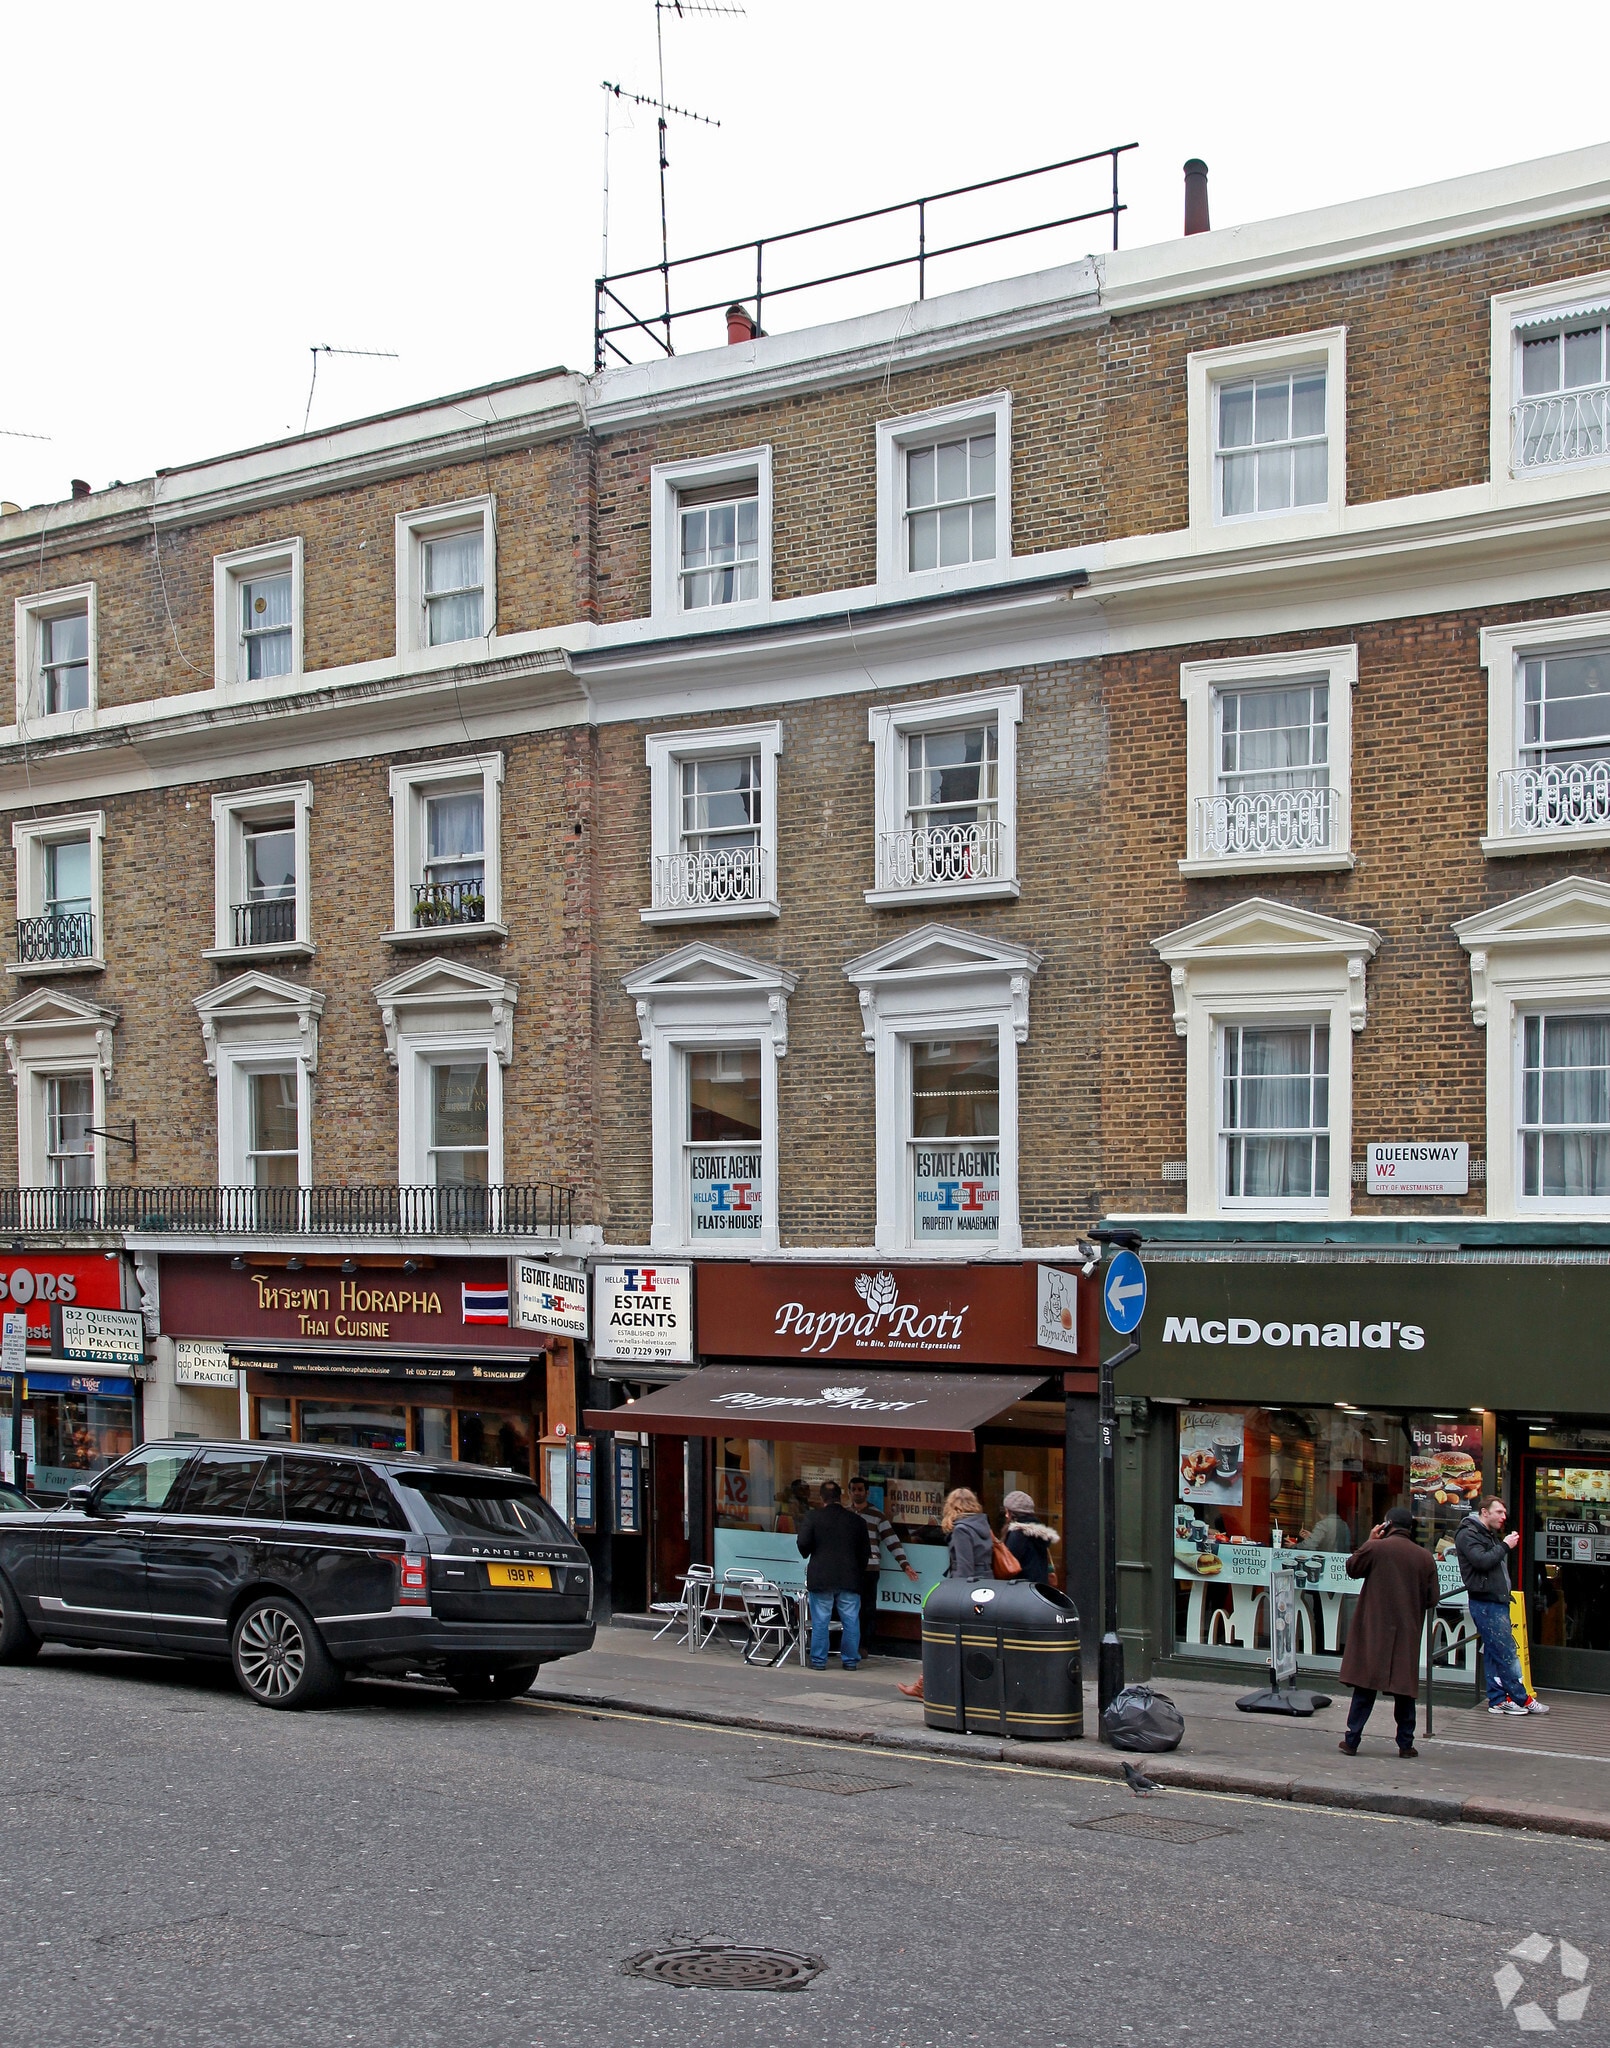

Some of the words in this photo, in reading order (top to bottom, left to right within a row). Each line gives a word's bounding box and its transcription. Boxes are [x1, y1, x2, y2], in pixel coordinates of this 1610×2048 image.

[1375, 1147, 1459, 1161] QUEENSWAY
[692, 1156, 727, 1179] ESTATE
[728, 1155, 762, 1179] AGENT
[917, 1152, 956, 1177] ESTATE
[1375, 1163, 1396, 1177] W2
[693, 1192, 717, 1203] HELLAS
[746, 1191, 762, 1202] HELVE
[917, 1191, 944, 1202] HELLAS
[977, 1190, 1000, 1202] HELVETI
[922, 1216, 954, 1231] PROPERTY
[521, 1266, 551, 1288] ESTATE
[552, 1273, 585, 1295] AGENTS
[604, 1276, 628, 1284] HELLAS
[652, 1277, 680, 1285] HELVETIA
[251, 1274, 329, 1311] โหระพา
[339, 1280, 442, 1314] HORAPHA
[523, 1293, 544, 1305] Hellas
[614, 1295, 672, 1310] ESTATE
[66, 1310, 82, 1321] 82
[86, 1311, 138, 1326] QUEENSWAY
[609, 1312, 677, 1328] AGENTS
[87, 1324, 139, 1338] DENTAL
[297, 1314, 329, 1336] THAI
[334, 1314, 390, 1338] CUISINE
[774, 1302, 876, 1353] Pappa
[888, 1304, 970, 1339] Roti
[617, 1329, 655, 1337] ESTABLISHED
[1039, 1324, 1060, 1345] Pappa
[1161, 1316, 1427, 1351] McDonald's
[88, 1337, 140, 1350] PRACTICE
[178, 1343, 191, 1353] 82
[608, 1338, 677, 1346] www.hellas-helvetia.com
[855, 1339, 869, 1347] One
[870, 1339, 886, 1348] Bite,
[888, 1340, 919, 1349] Different
[920, 1341, 961, 1350] Expressions
[69, 1349, 87, 1358] 020
[90, 1350, 113, 1360] 7229
[116, 1353, 139, 1362] 6248
[616, 1346, 630, 1355] 020
[633, 1347, 652, 1355] 7229
[654, 1348, 672, 1356] 9917
[194, 1356, 228, 1368] DENTA
[194, 1370, 234, 1382] PRACTICE
[1102, 1426, 1110, 1436] S
[1412, 1430, 1431, 1445] Big
[1103, 1436, 1111, 1446] 5
[45, 1472, 68, 1484] Four
[1548, 1522, 1566, 1533] free
[1566, 1523, 1586, 1533] WiFi
[471, 1547, 520, 1556] RANGE
[528, 1551, 569, 1559] ROVER
[1232, 1548, 1261, 1557] worth
[1232, 1557, 1267, 1569] getting
[507, 1568, 526, 1582] 198
[527, 1569, 535, 1582] R
[1232, 1567, 1246, 1576] up
[1247, 1565, 1260, 1576] for
[880, 1589, 923, 1605] BUNS
[760, 1607, 775, 1617] NIKE
